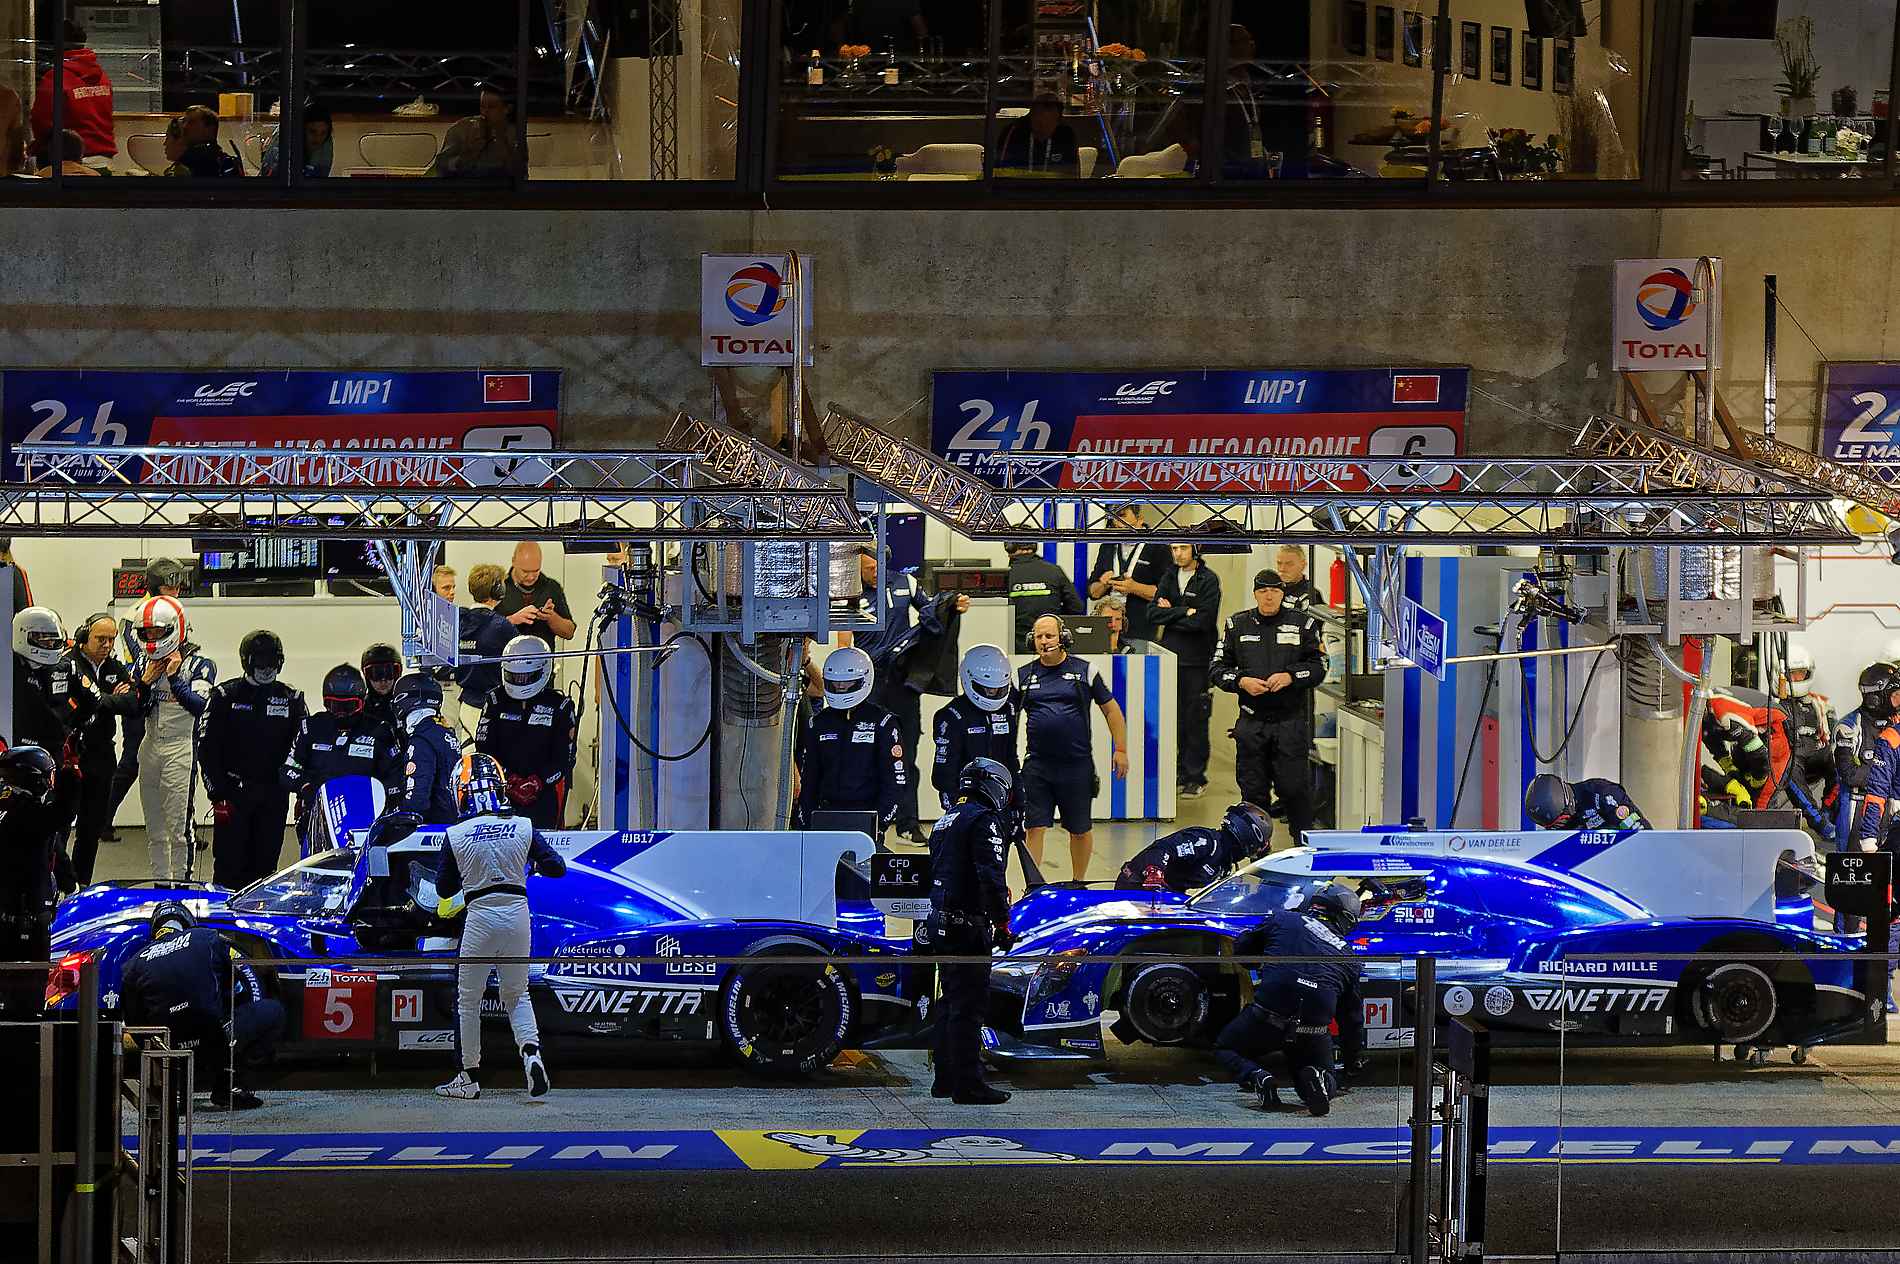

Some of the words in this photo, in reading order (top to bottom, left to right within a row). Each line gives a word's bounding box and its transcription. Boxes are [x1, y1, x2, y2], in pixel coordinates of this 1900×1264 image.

[328, 379, 392, 404] LMP1
[1243, 379, 1307, 404] LMP1
[948, 399, 1051, 450] 24h
[494, 434, 523, 478] 5
[1398, 434, 1426, 478] 6
[1835, 445, 1864, 458] LE
[1402, 606, 1410, 651] 6
[555, 837, 571, 845] LEE
[621, 833, 655, 844] #JB17
[1468, 839, 1485, 848] VAN
[1488, 839, 1504, 847] DER
[1507, 838, 1521, 847] LEE
[1580, 833, 1616, 844] #JB17
[888, 859, 910, 868] CFD
[1842, 858, 1863, 867] CFD
[308, 971, 329, 981] 24h
[1539, 961, 1607, 972] RICHARD
[1612, 962, 1657, 971] MILLE
[333, 974, 375, 983] TOTAL
[323, 988, 354, 1033] 5
[395, 995, 417, 1018] P1
[554, 990, 702, 1014] GINETTA
[728, 980, 742, 1039] MICHELIN
[836, 981, 850, 1039] MICHELIN
[1522, 989, 1670, 1012] GINETTA
[1366, 1003, 1388, 1025] P1
